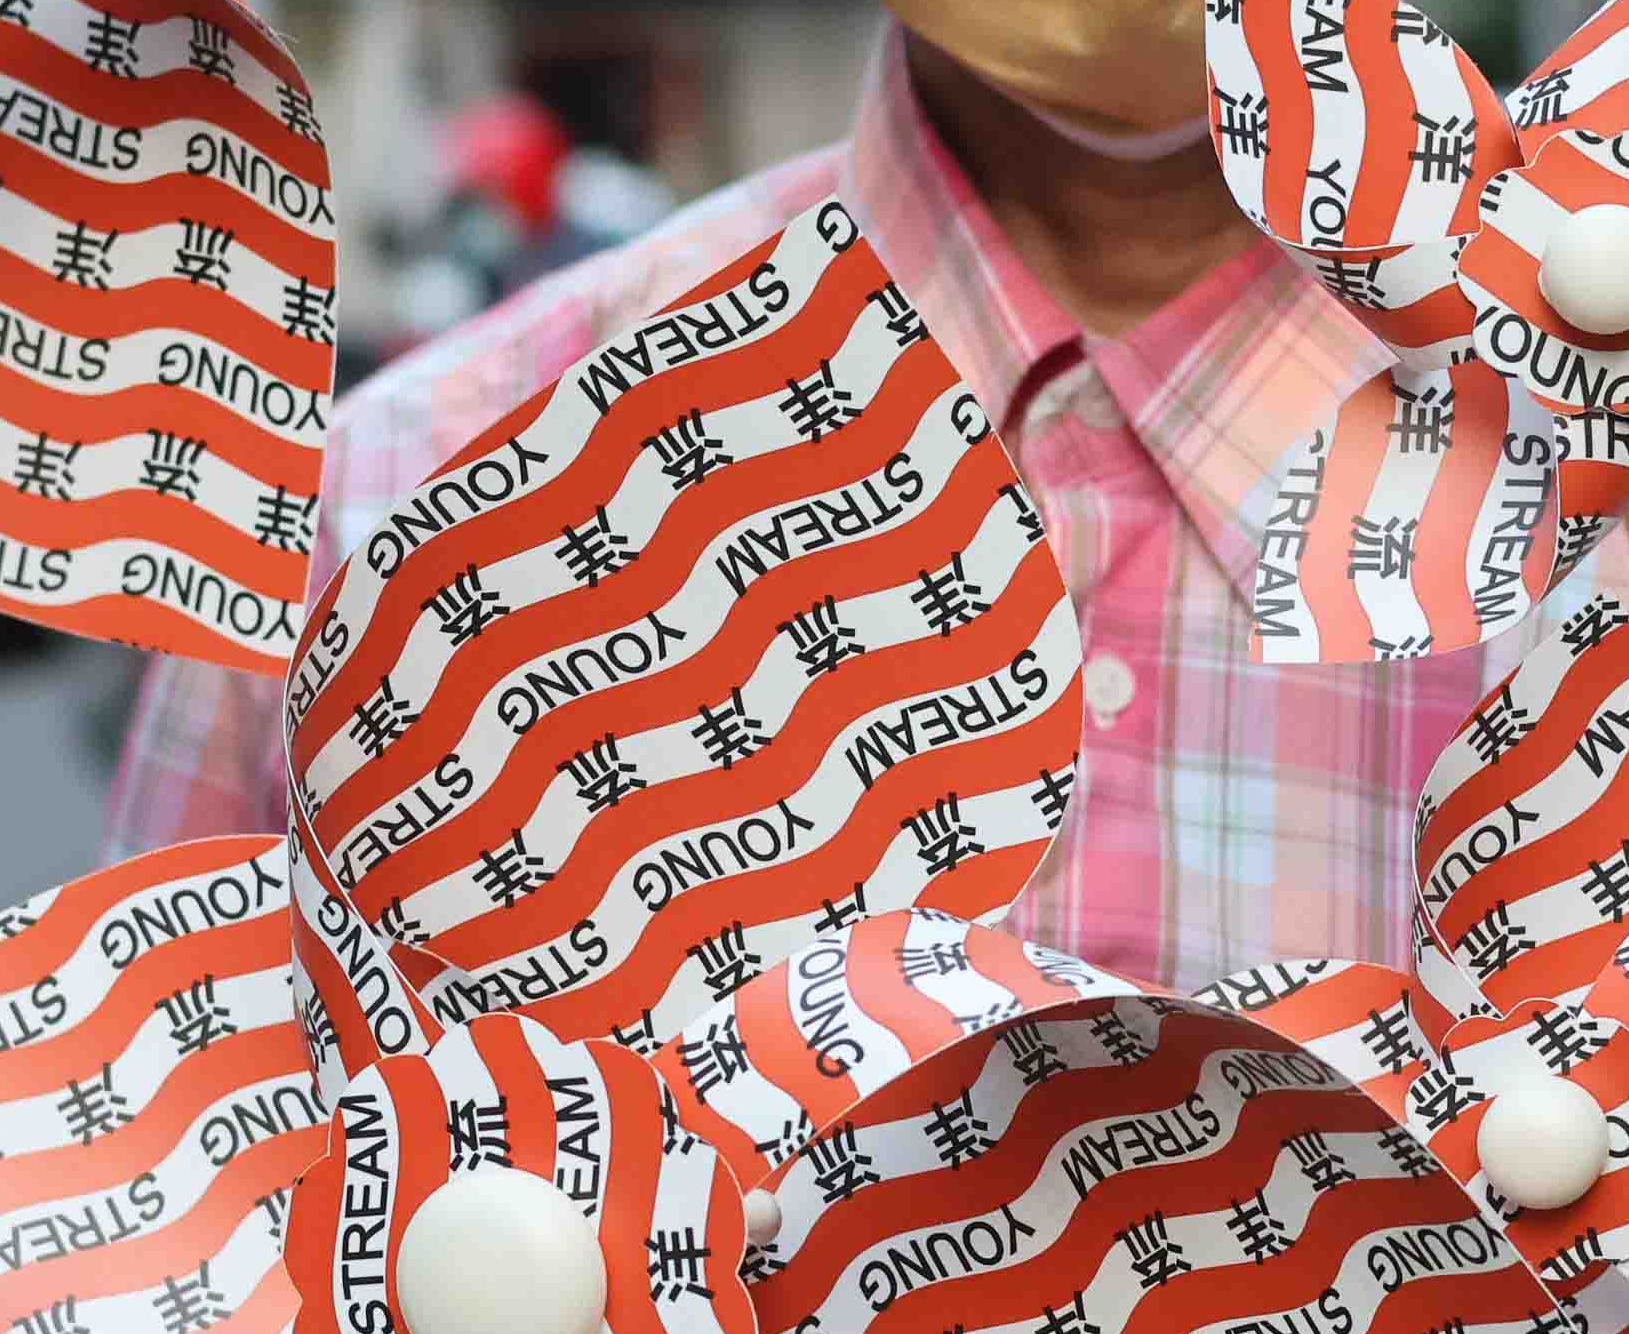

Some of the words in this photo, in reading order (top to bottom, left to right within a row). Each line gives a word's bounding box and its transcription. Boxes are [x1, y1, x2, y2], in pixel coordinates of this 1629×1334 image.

[187, 133, 335, 224] YOUNG
[159, 343, 326, 430] YOUNG
[576, 261, 789, 421] STREAM
[363, 437, 551, 581] YOUNG
[710, 452, 927, 604] STREAM
[1473, 426, 1555, 627] STREAM
[121, 553, 297, 640] YOUNG
[497, 606, 687, 735] YOUNG
[845, 648, 1048, 795] STREAM
[336, 750, 475, 891] STREA
[633, 796, 815, 916] YOUNG
[1420, 797, 1540, 916] YOUN
[100, 856, 284, 969] YOUNG
[316, 890, 414, 1056] OUNG
[429, 918, 608, 1031] STREAM
[799, 939, 864, 1079] OUNG
[1056, 1088, 1220, 1206] STREAM
[859, 1198, 1040, 1316] YOUNG
[1363, 1212, 1507, 1299] YOUNG
